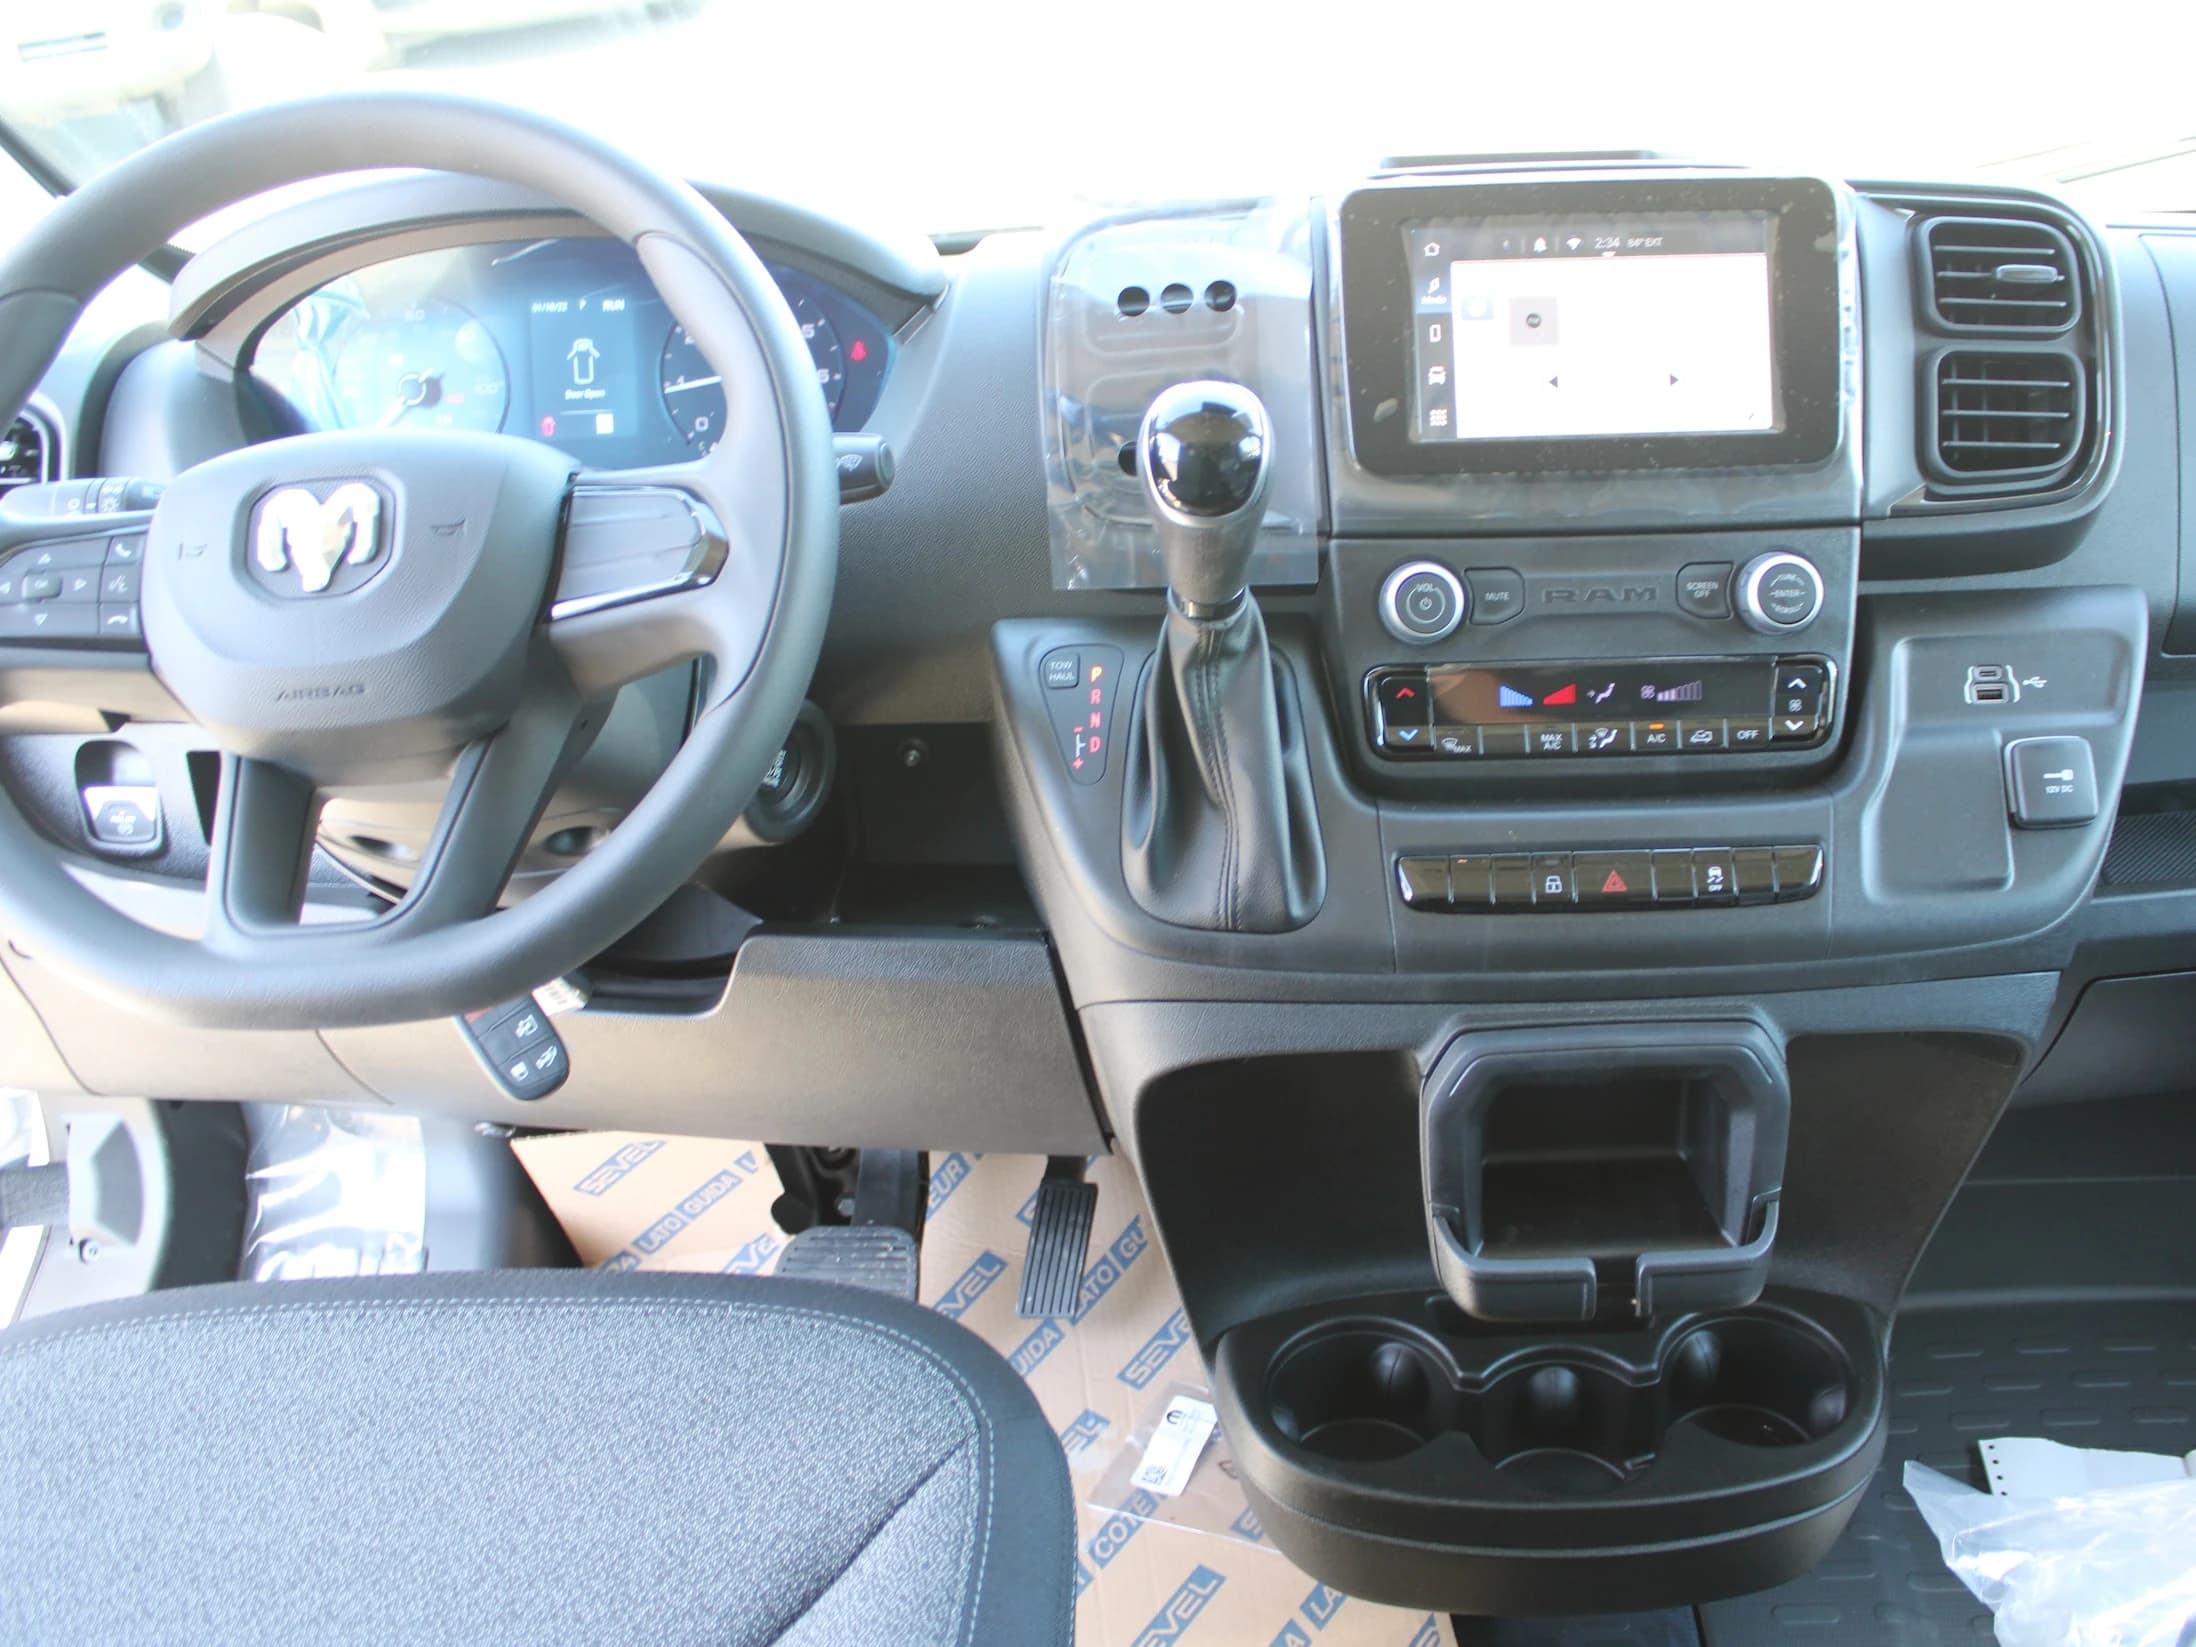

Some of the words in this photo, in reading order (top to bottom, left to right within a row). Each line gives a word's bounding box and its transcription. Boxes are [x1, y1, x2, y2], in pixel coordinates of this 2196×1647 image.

[694, 416, 709, 432] 0
[1686, 581, 1719, 591] SCREEN
[1485, 592, 1510, 601] MUTE
[1543, 586, 1657, 604] RAM
[1693, 590, 1710, 598] OFF
[1050, 660, 1073, 671] TOW
[1048, 671, 1075, 682] HAUL
[1090, 665, 1103, 683] P
[277, 684, 364, 702] AIRBAG
[1090, 688, 1101, 705] R
[1090, 711, 1101, 729] N
[1541, 733, 1563, 742] MAX
[1647, 734, 1667, 744] A/C
[1736, 730, 1759, 740] OFF
[1089, 736, 1101, 753] D
[1543, 741, 1561, 751] A/C
[577, 1140, 663, 1194] SEVEL
[638, 1215, 682, 1251] LATO
[683, 1172, 739, 1215] GUIDA
